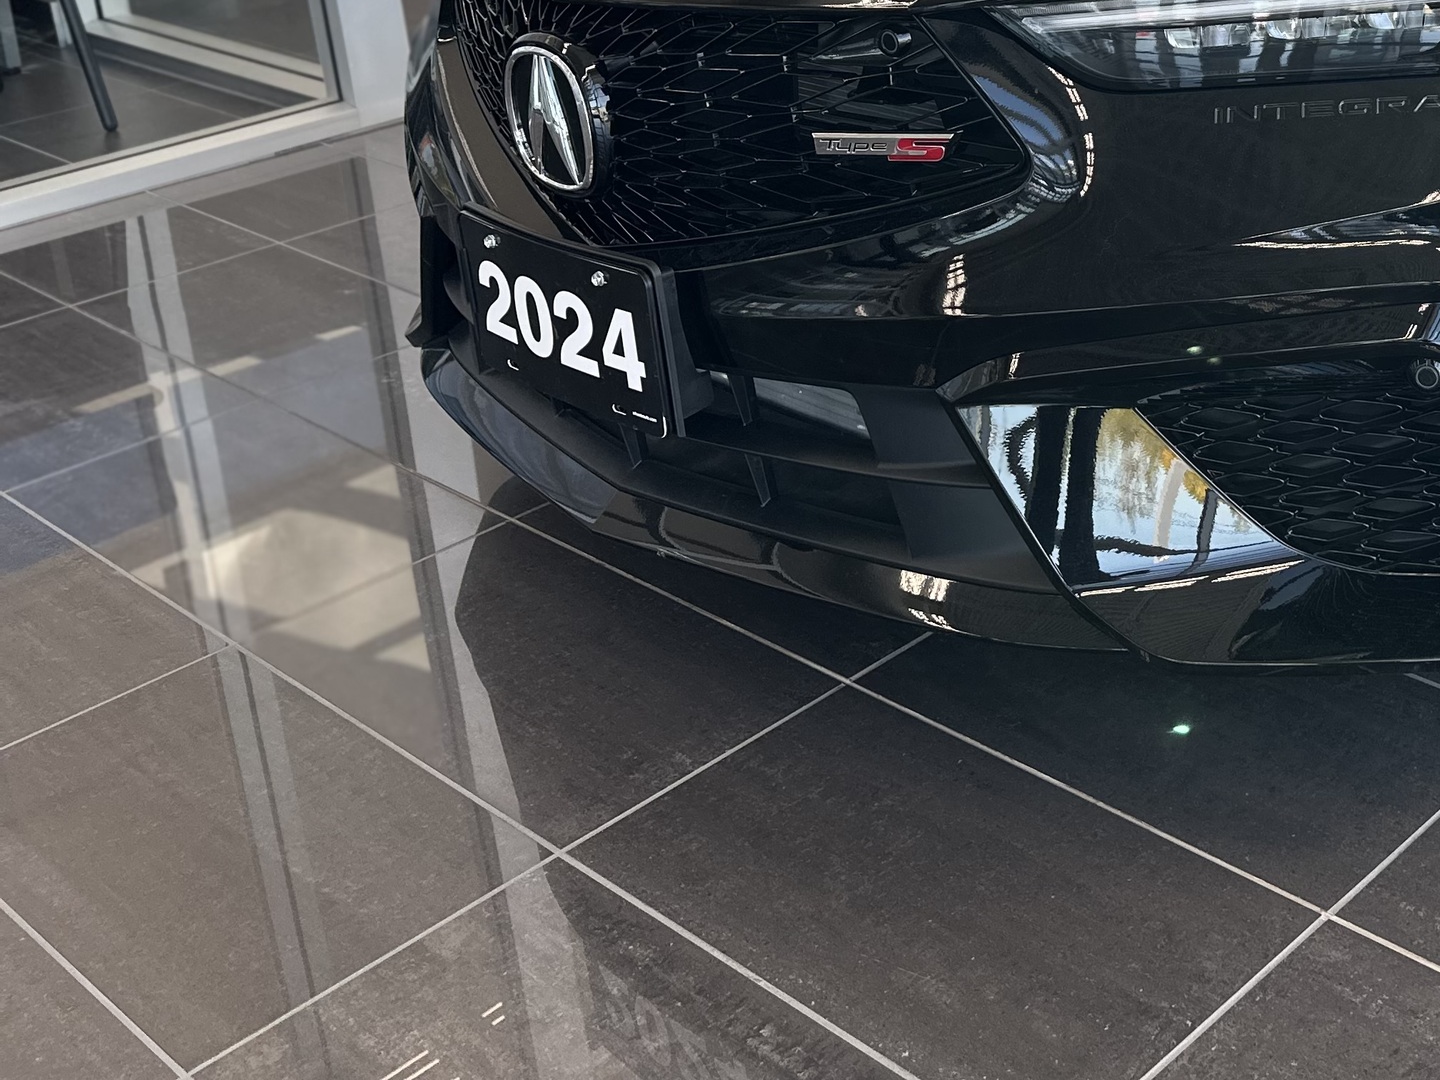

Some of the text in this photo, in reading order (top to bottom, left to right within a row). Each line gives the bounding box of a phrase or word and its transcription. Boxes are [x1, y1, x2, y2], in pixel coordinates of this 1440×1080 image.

[819, 137, 950, 162] Type S
[478, 260, 647, 393] 2024
